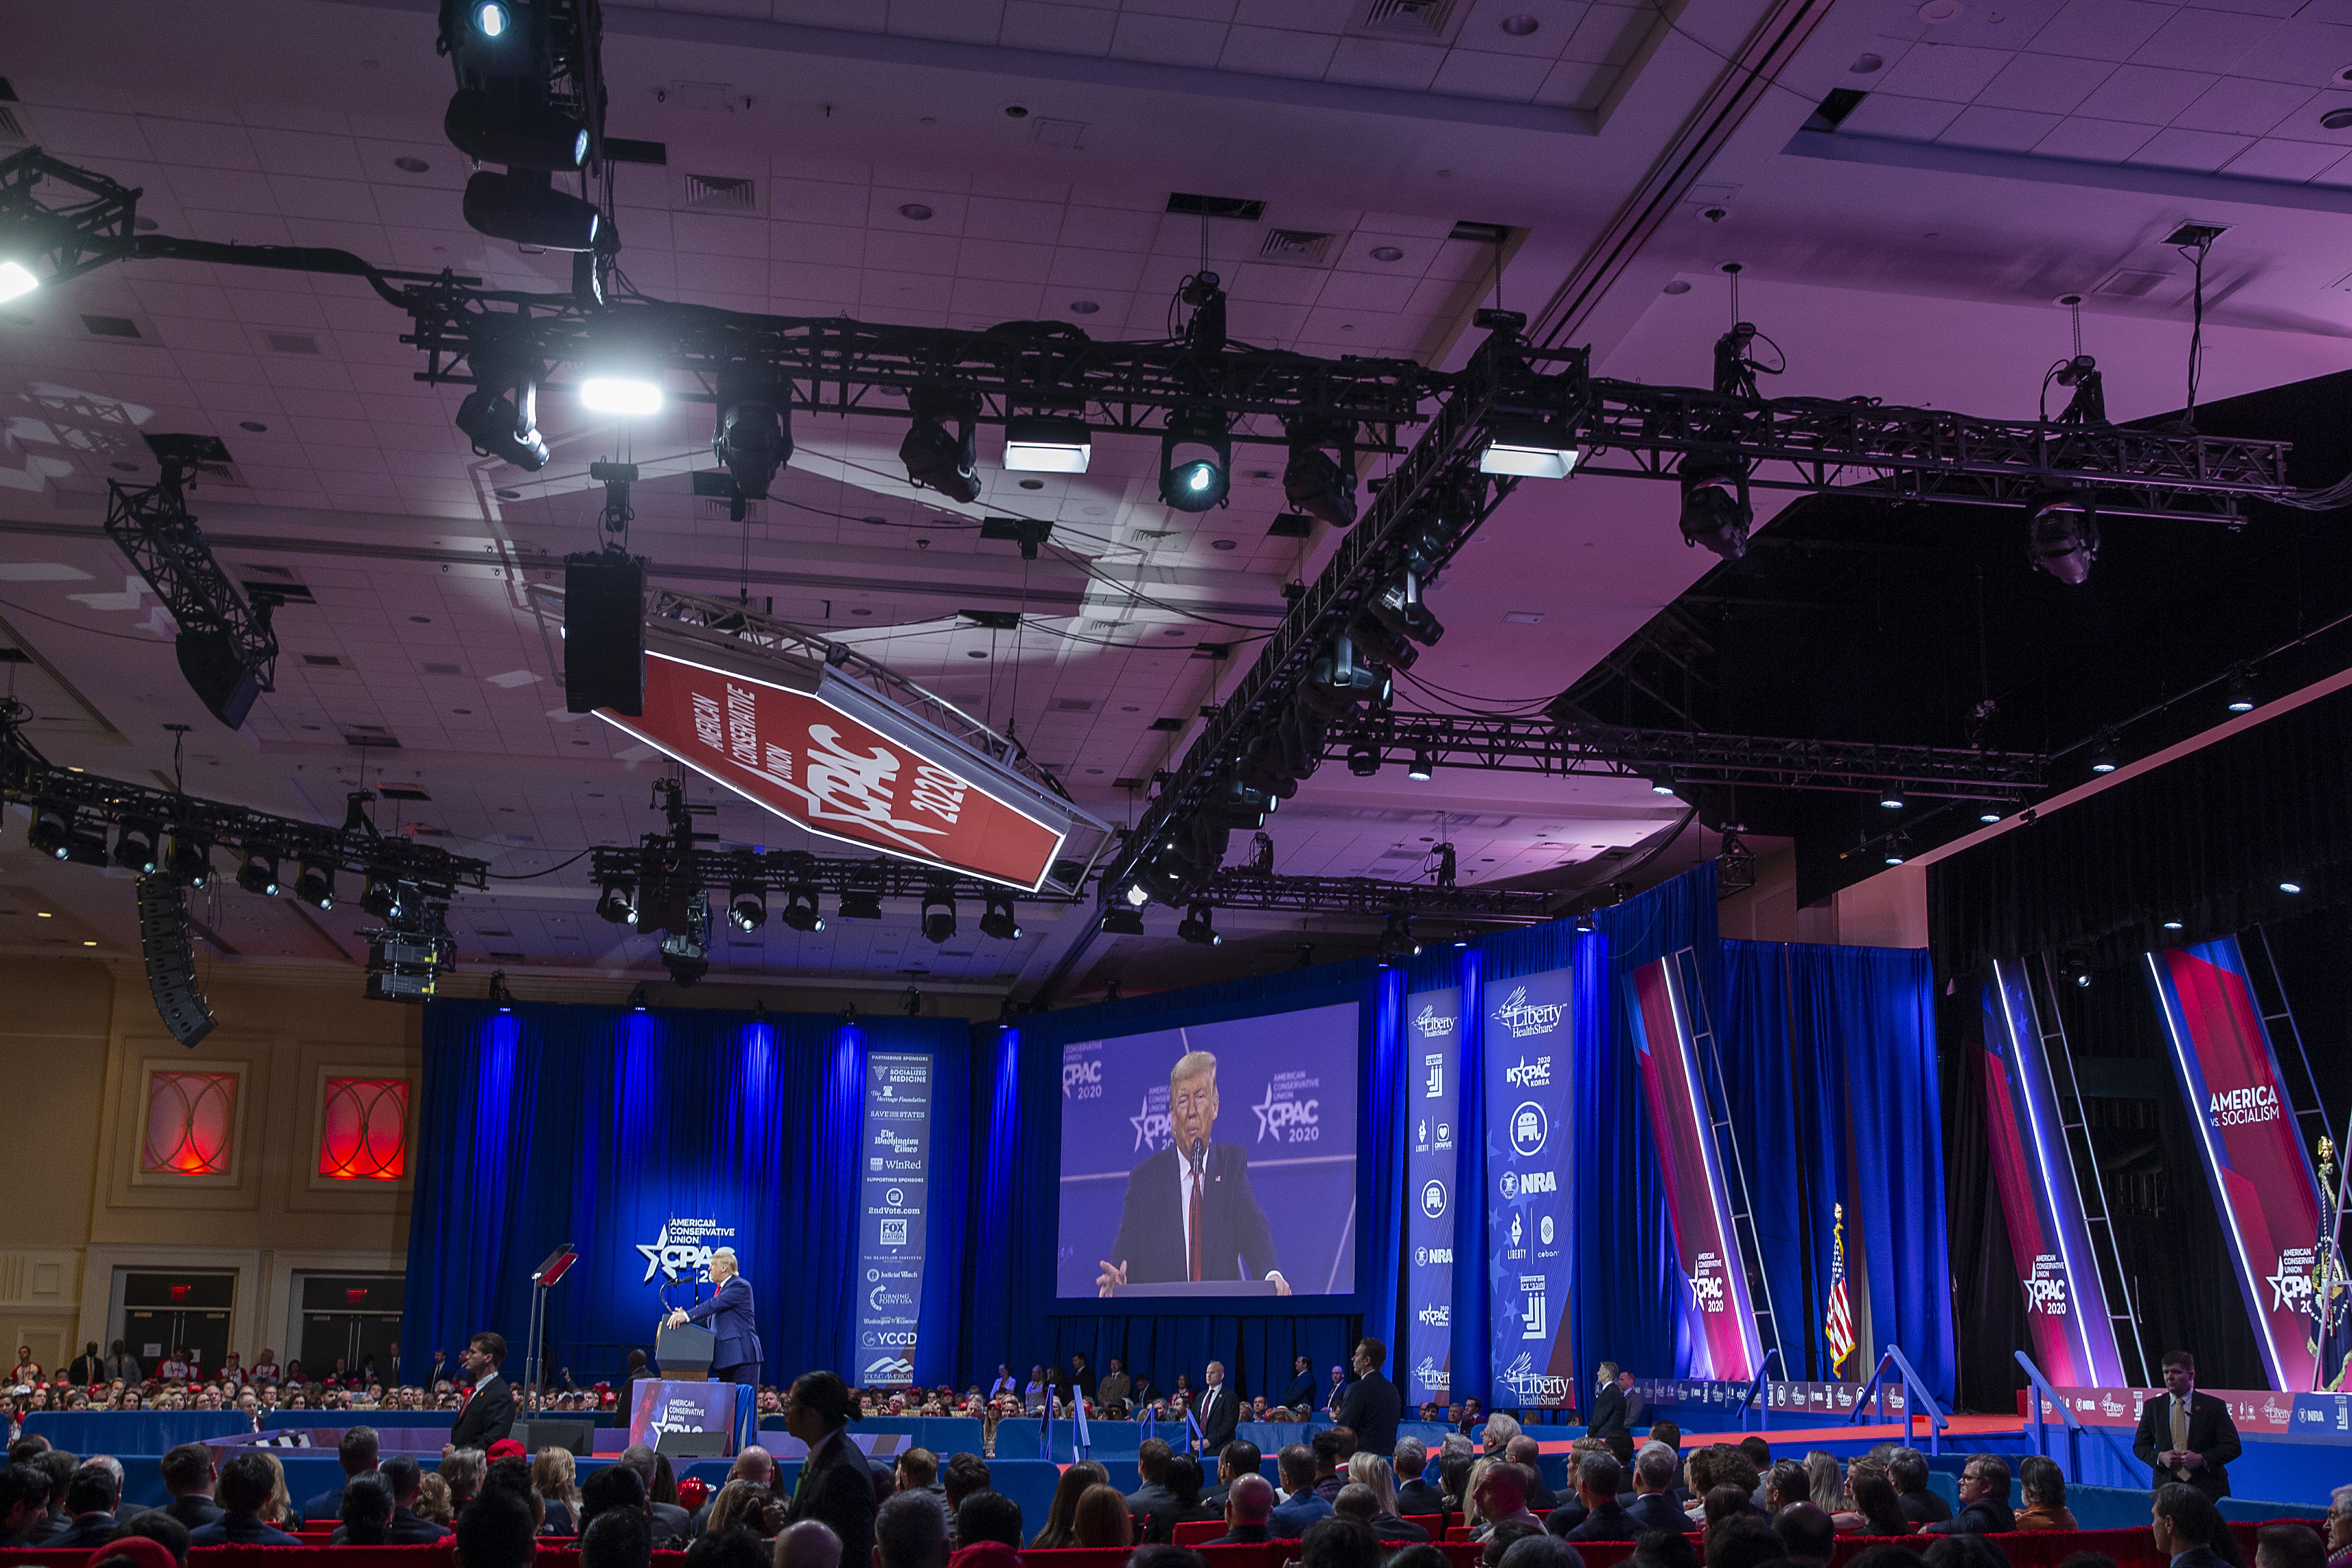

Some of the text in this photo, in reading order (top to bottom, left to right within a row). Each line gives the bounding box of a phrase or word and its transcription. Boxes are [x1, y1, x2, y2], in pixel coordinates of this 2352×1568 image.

[692, 692, 724, 753] AMERICAN
[726, 682, 759, 766] CONSERVATIVE
[765, 742, 792, 780] UNION
[807, 724, 900, 821] CPAC
[910, 765, 968, 824] 2020
[1512, 1004, 1562, 1027] Liberty
[1425, 1017, 1455, 1032] Liberty
[1513, 1024, 1553, 1038] HealthShare
[1538, 1056, 1551, 1064] 2020
[1064, 1061, 1102, 1085] CPAC
[1530, 1078, 1550, 1087] KOREA
[1078, 1084, 1102, 1100] 2020
[2210, 1085, 2278, 1112] AMERICA
[1268, 1099, 1319, 1127] CPAC
[2222, 1105, 2279, 1126] SOCIALISM
[1143, 1113, 1171, 1137] CPA
[881, 1129, 894, 1138] The
[1289, 1126, 1319, 1143] 2020
[874, 1136, 918, 1147] Washington
[894, 1144, 918, 1153] Times
[886, 1160, 921, 1170] WinRed
[1521, 1171, 1557, 1194] NRA
[671, 1218, 716, 1228] AMERICAN
[882, 1223, 905, 1232] FOX
[670, 1227, 735, 1236] CONSERVATIVE
[669, 1236, 700, 1245] UNION
[1429, 1248, 1453, 1264] NRA
[1507, 1248, 1527, 1260] LIBERTY
[1698, 1252, 1715, 1260] AMERICAN
[2284, 1248, 2311, 1257] AMERICAN
[1698, 1259, 1722, 1269] CONSERVATIVE
[2036, 1262, 2065, 1270] CONSERVATIVE
[2284, 1257, 2315, 1265] CONSERVAT
[2284, 1265, 2302, 1274] UNION
[1696, 1276, 1723, 1299] CPAC
[2033, 1279, 2066, 1301] CPAC
[2280, 1275, 2312, 1298] CPA
[1708, 1299, 1724, 1312] 2020
[2047, 1302, 2066, 1315] 2020
[877, 1332, 917, 1345] YCCD
[1424, 1369, 1450, 1384] Libert
[1518, 1373, 1570, 1400] Liberty
[669, 1398, 695, 1408] AMERICAN
[1518, 1394, 1561, 1405] HealthShare
[2083, 1399, 2096, 1411] NRA
[668, 1406, 705, 1417] CONSERVATIVE
[668, 1414, 685, 1422] UNION
[2308, 1410, 2324, 1422] NRA
